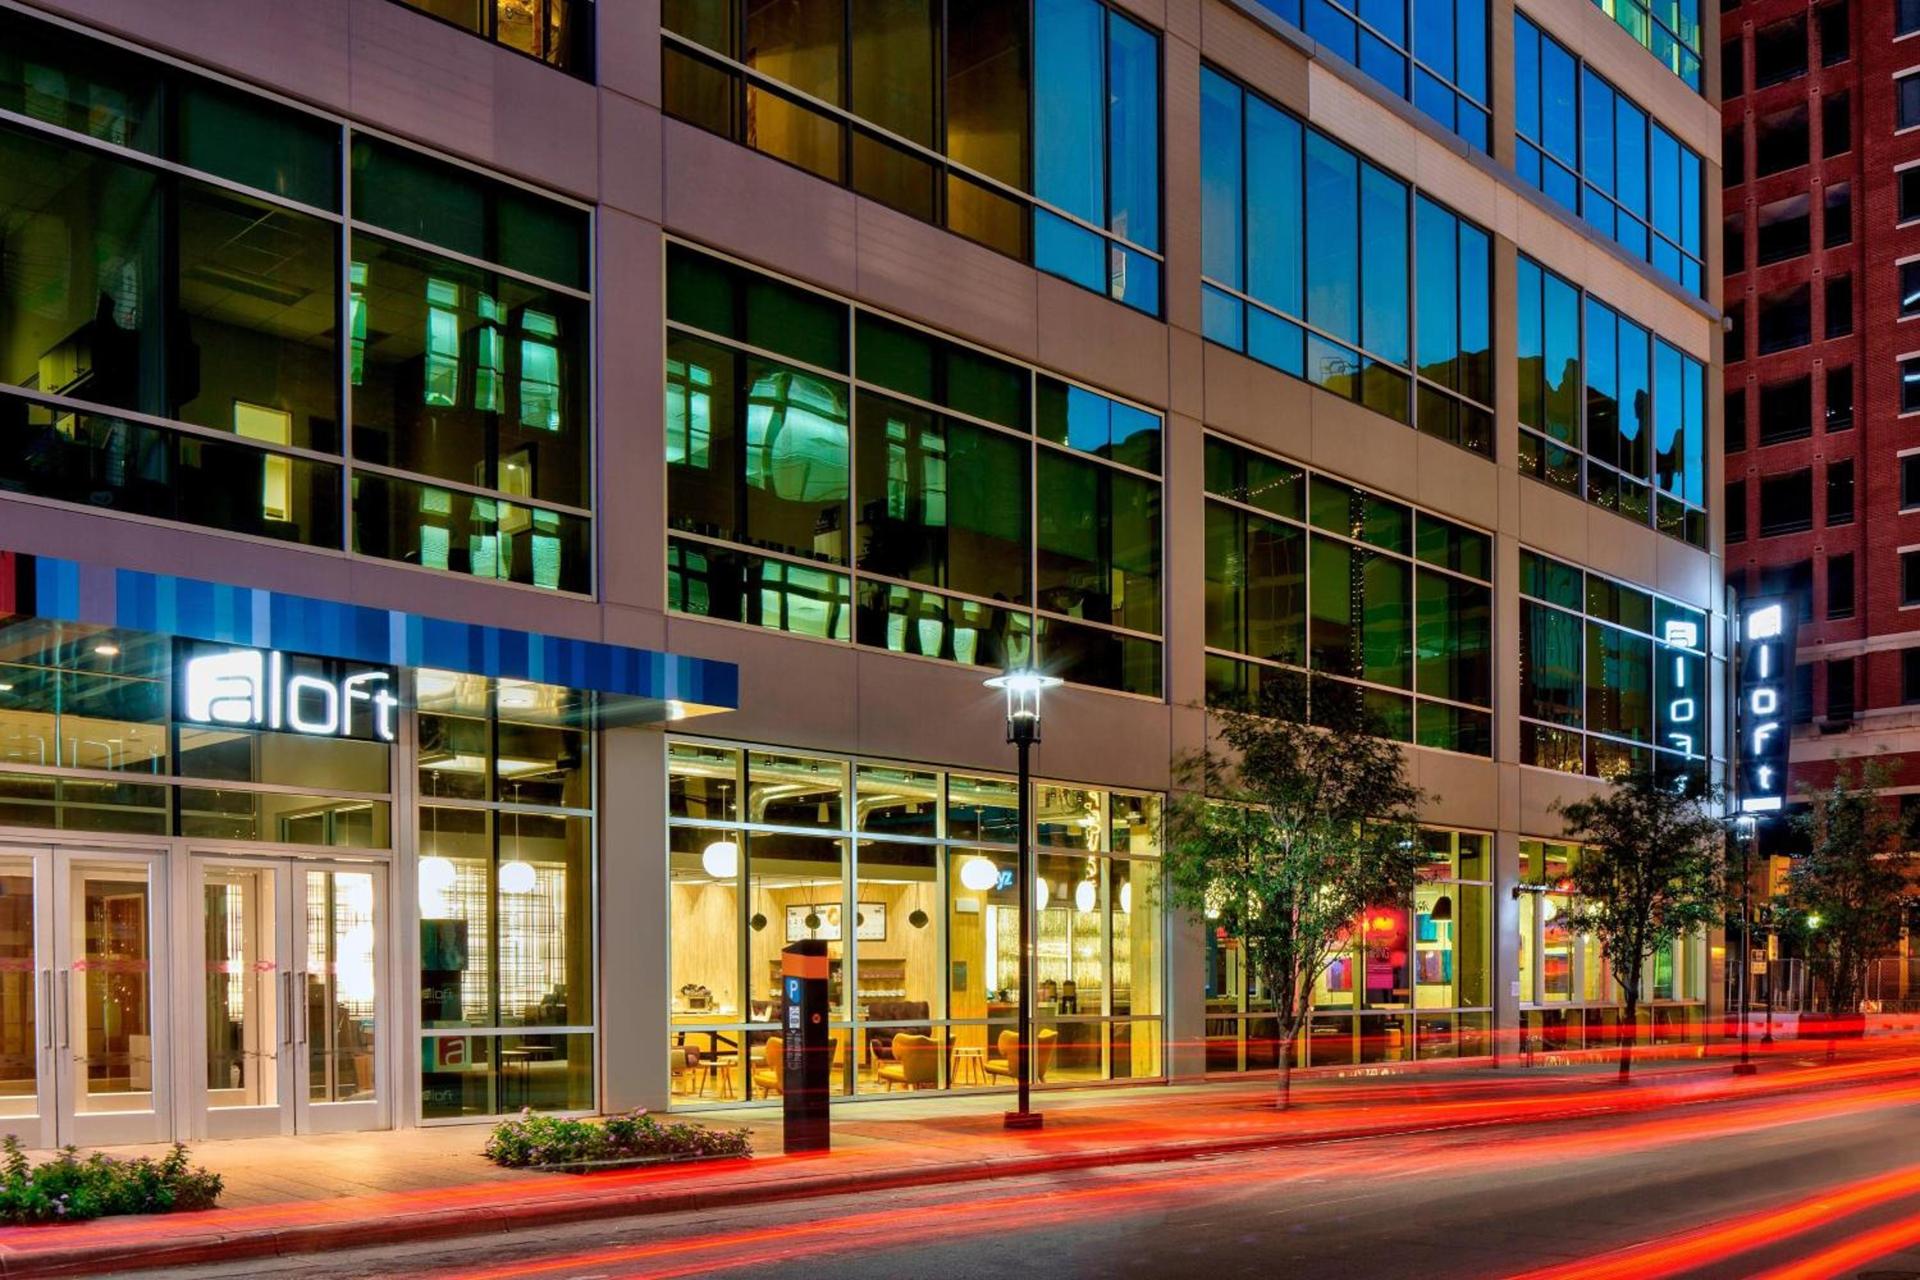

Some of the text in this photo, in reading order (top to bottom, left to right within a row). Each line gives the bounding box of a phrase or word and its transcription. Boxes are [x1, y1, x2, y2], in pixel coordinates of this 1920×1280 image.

[186, 649, 398, 741] aloft
[1748, 604, 1782, 790] aloft
[789, 980, 799, 1000] P
[445, 1039, 465, 1066] a
